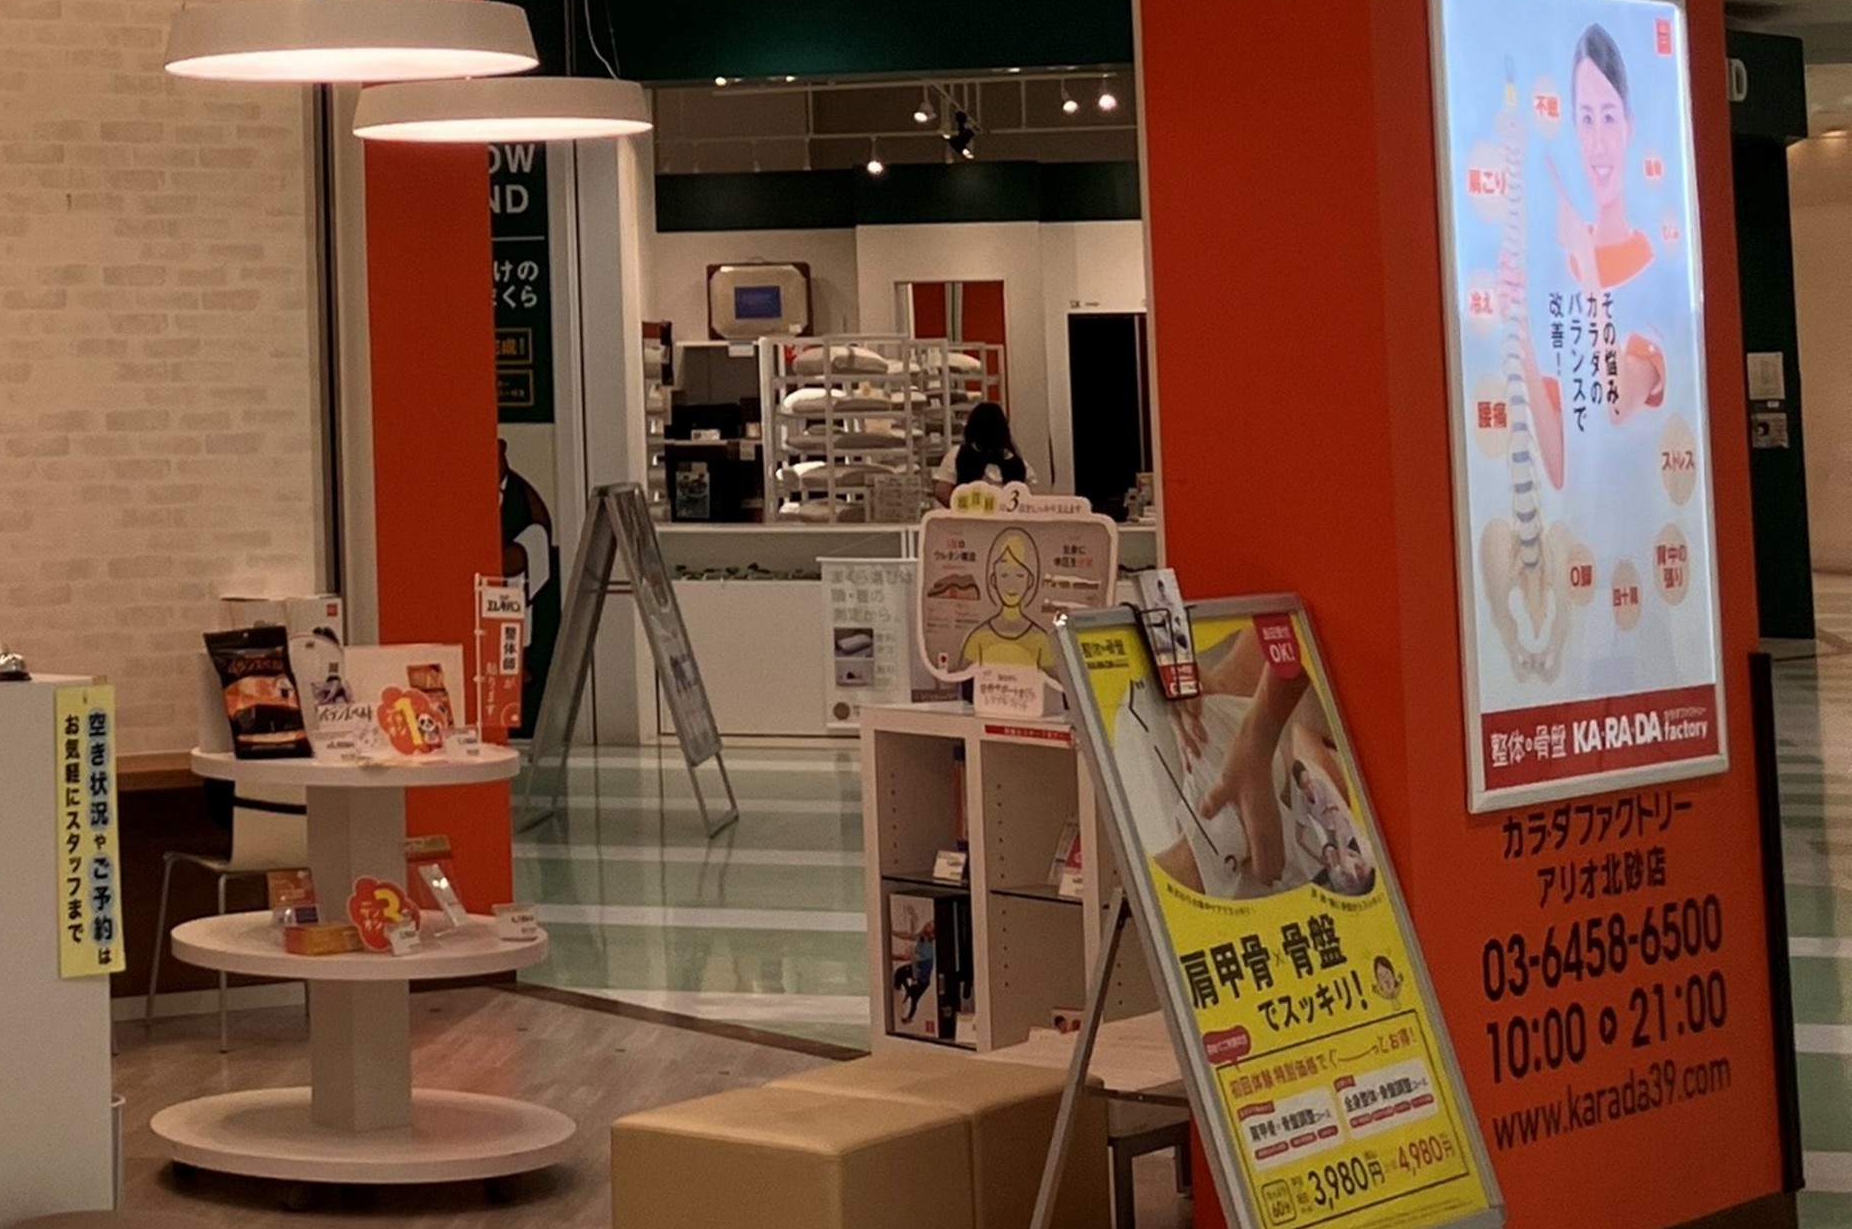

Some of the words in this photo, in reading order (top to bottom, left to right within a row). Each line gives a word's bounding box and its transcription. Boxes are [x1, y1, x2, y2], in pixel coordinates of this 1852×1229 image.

[1568, 292, 1586, 432] バランスで
[1586, 296, 1602, 405] カラダの
[1603, 292, 1620, 416] その悩み、
[1477, 400, 1508, 429] 腰痛
[1662, 450, 1695, 472] ストレス
[1269, 642, 1295, 663] OK!
[1664, 719, 1708, 741] factory
[64, 714, 84, 943] お気軽にスタッフまで
[88, 711, 113, 965] 空き状況やご予約は
[1503, 791, 1693, 859] カラダファクトリー
[1537, 845, 1667, 909] アリオ北砂店
[1482, 894, 1723, 1002] 03-6458-6500
[1257, 969, 1369, 1032] でスッキリ!
[1486, 1002, 1587, 1084] 10:00
[1629, 969, 1728, 1049] 21:00
[1492, 1056, 1731, 1151] www.karada39.com
[1307, 1156, 1386, 1210] 3,980円
